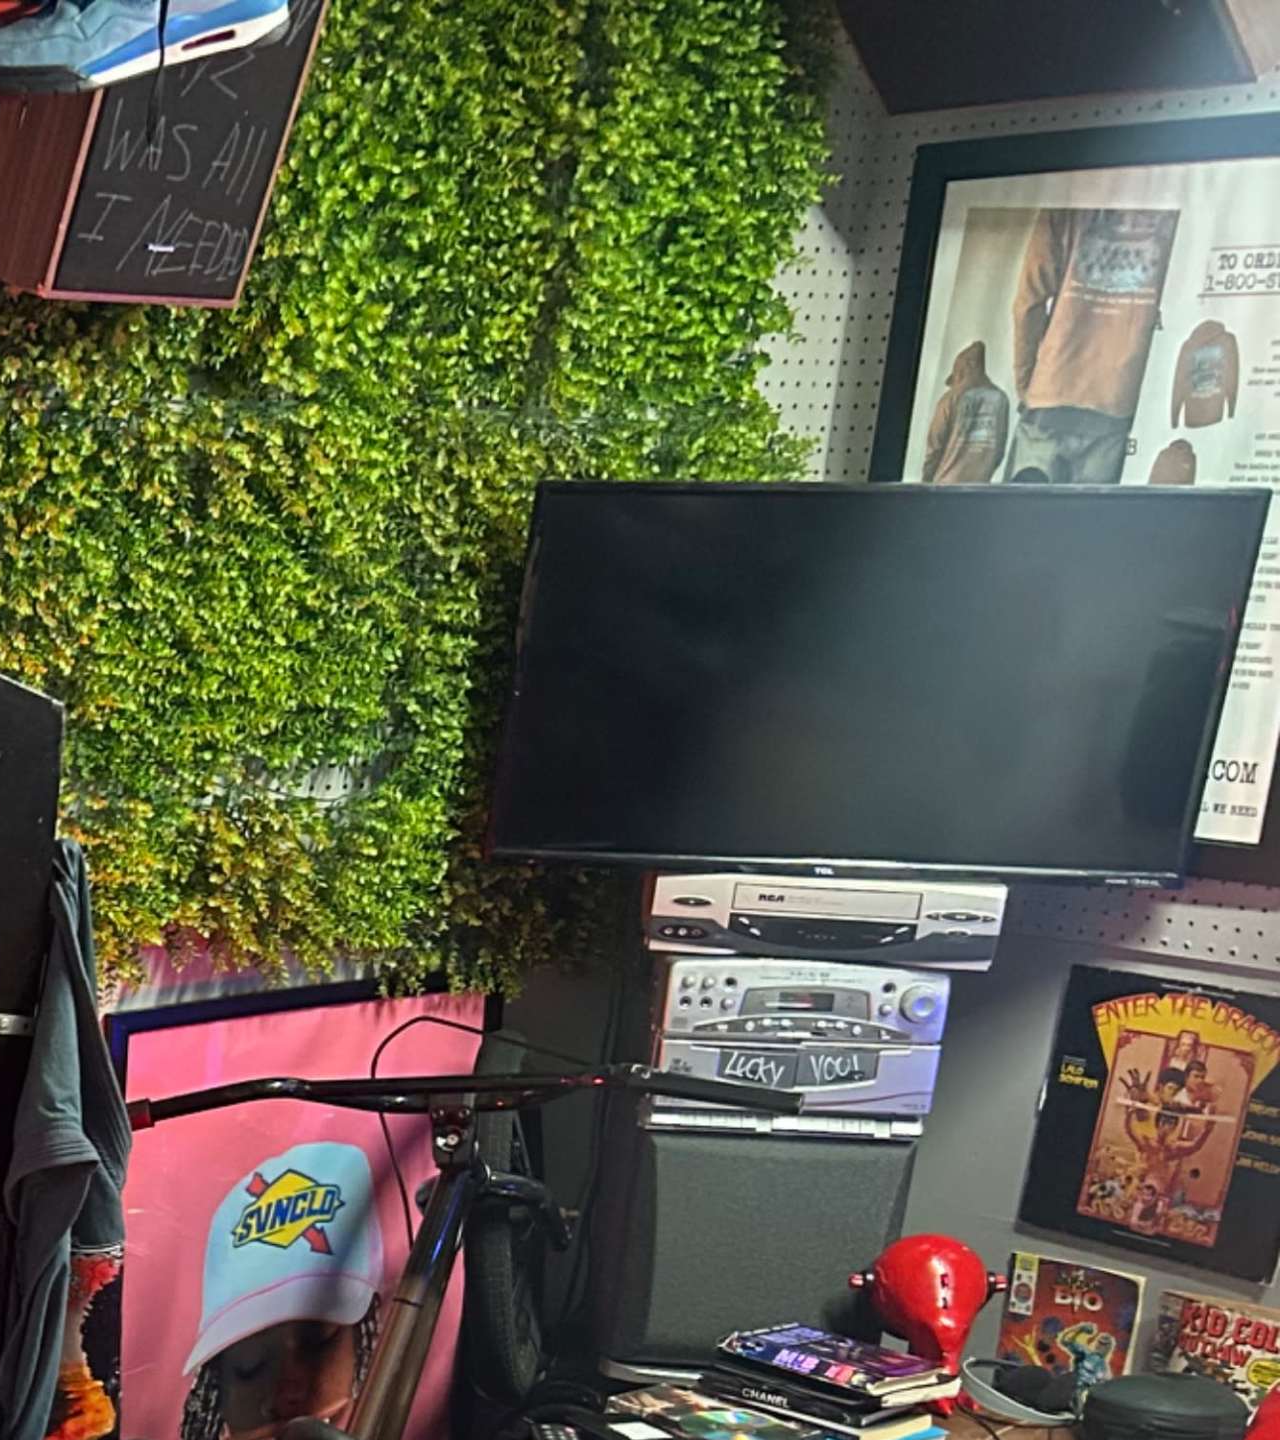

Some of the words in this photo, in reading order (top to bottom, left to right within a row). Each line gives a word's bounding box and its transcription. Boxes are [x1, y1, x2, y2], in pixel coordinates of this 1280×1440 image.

[102, 97, 199, 182] WAS
[757, 892, 786, 903] RCA
[1092, 992, 1159, 1028] ENTER
[1163, 992, 1208, 1021] THE
[1180, 1300, 1229, 1336] KID
[1231, 1315, 1280, 1355] COL
[741, 1387, 791, 1410] CHANEL
